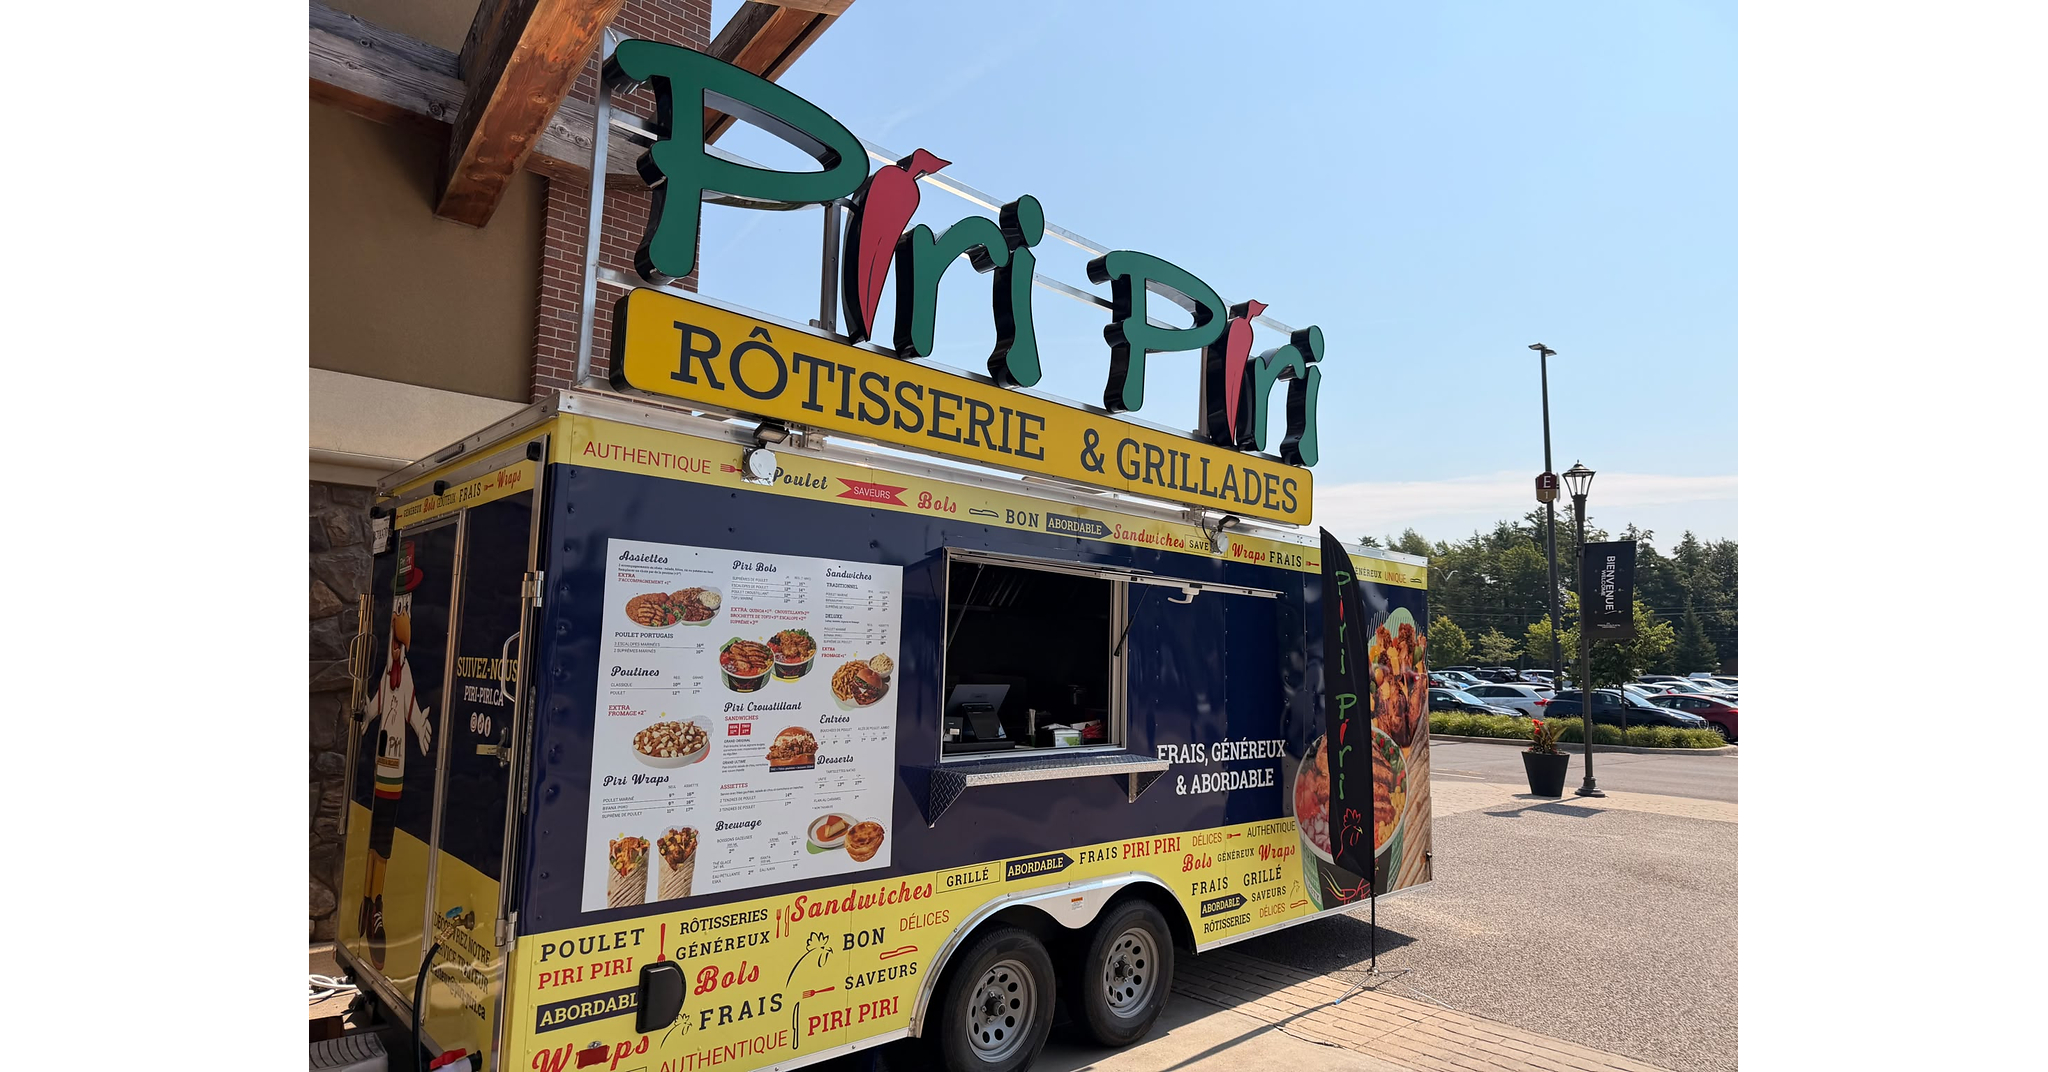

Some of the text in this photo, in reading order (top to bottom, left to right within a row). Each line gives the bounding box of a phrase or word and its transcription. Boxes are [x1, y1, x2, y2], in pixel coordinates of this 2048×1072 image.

[608, 38, 1324, 467] Piri Piri
[670, 320, 1298, 514] RÔTISSERIE & GRILLADES
[459, 482, 482, 503] FRAIS
[497, 469, 522, 489] Wraps
[1543, 476, 1551, 488] E
[583, 441, 711, 475] AUTHENTIQUE
[773, 466, 828, 490] Poulet
[853, 486, 891, 499] SAVEURS
[917, 490, 957, 513] Bols
[1005, 508, 1039, 528] BON
[1048, 518, 1102, 536] ABORDABLE
[1113, 523, 1185, 549] Sandwiches
[1231, 542, 1266, 562] Wraps
[1269, 550, 1303, 568] FRAIS
[1354, 567, 1382, 579] ÉNÉREUX
[1384, 571, 1407, 583] UNIQUE
[618, 550, 669, 564] Assiettes
[732, 560, 777, 572] Piri Bols
[825, 568, 872, 580] Sandwiches
[1605, 555, 1616, 611] BIENVENUE
[456, 656, 517, 682] SUIVEZ-NOUS
[610, 665, 660, 677] Poutines
[463, 685, 504, 707] PIRI-PIRI.CA
[1335, 570, 1357, 800] Piri Piri
[724, 701, 802, 712] Piri Croustillant
[819, 714, 850, 724] Entrées
[816, 754, 854, 765] Desserts
[1157, 737, 1287, 766] FRAIS, GÉNÉREUX
[602, 773, 670, 787] Piri Wraps
[720, 782, 748, 790] ASSIETTES
[1176, 768, 1274, 796] & ABORDABLE
[714, 819, 763, 832] Breuvage
[790, 820, 1296, 923] Sandwiches GRILLÉ ABORDABLE FRAIS PIRI PIRI DÉLICES AUTHENTIQUE
[1182, 843, 1295, 873] Bols GÉNÉREUX Wraps
[1191, 864, 1282, 897] FRAIS GRILLÉ
[1202, 885, 1287, 914] ABORDABLE SAVEURS
[679, 908, 768, 935] RÔTISSERIES
[842, 909, 950, 952] BON DÉLICES
[1203, 902, 1286, 934] RÔTISSERIES DÉLICES
[467, 939, 491, 967] NOTRE
[540, 928, 645, 962] POULET
[676, 930, 770, 961] GÉNÉREUX
[537, 957, 633, 990] PIRI PIRI
[693, 960, 760, 996] Bols
[845, 962, 918, 990] SAVEURS
[539, 992, 639, 1027] ABORDABL
[699, 993, 783, 1030] FRAIS
[807, 996, 899, 1036] PIRI PIRI
[532, 1035, 650, 1072] Wps
[660, 1029, 788, 1072] AUTHENTIQUE
